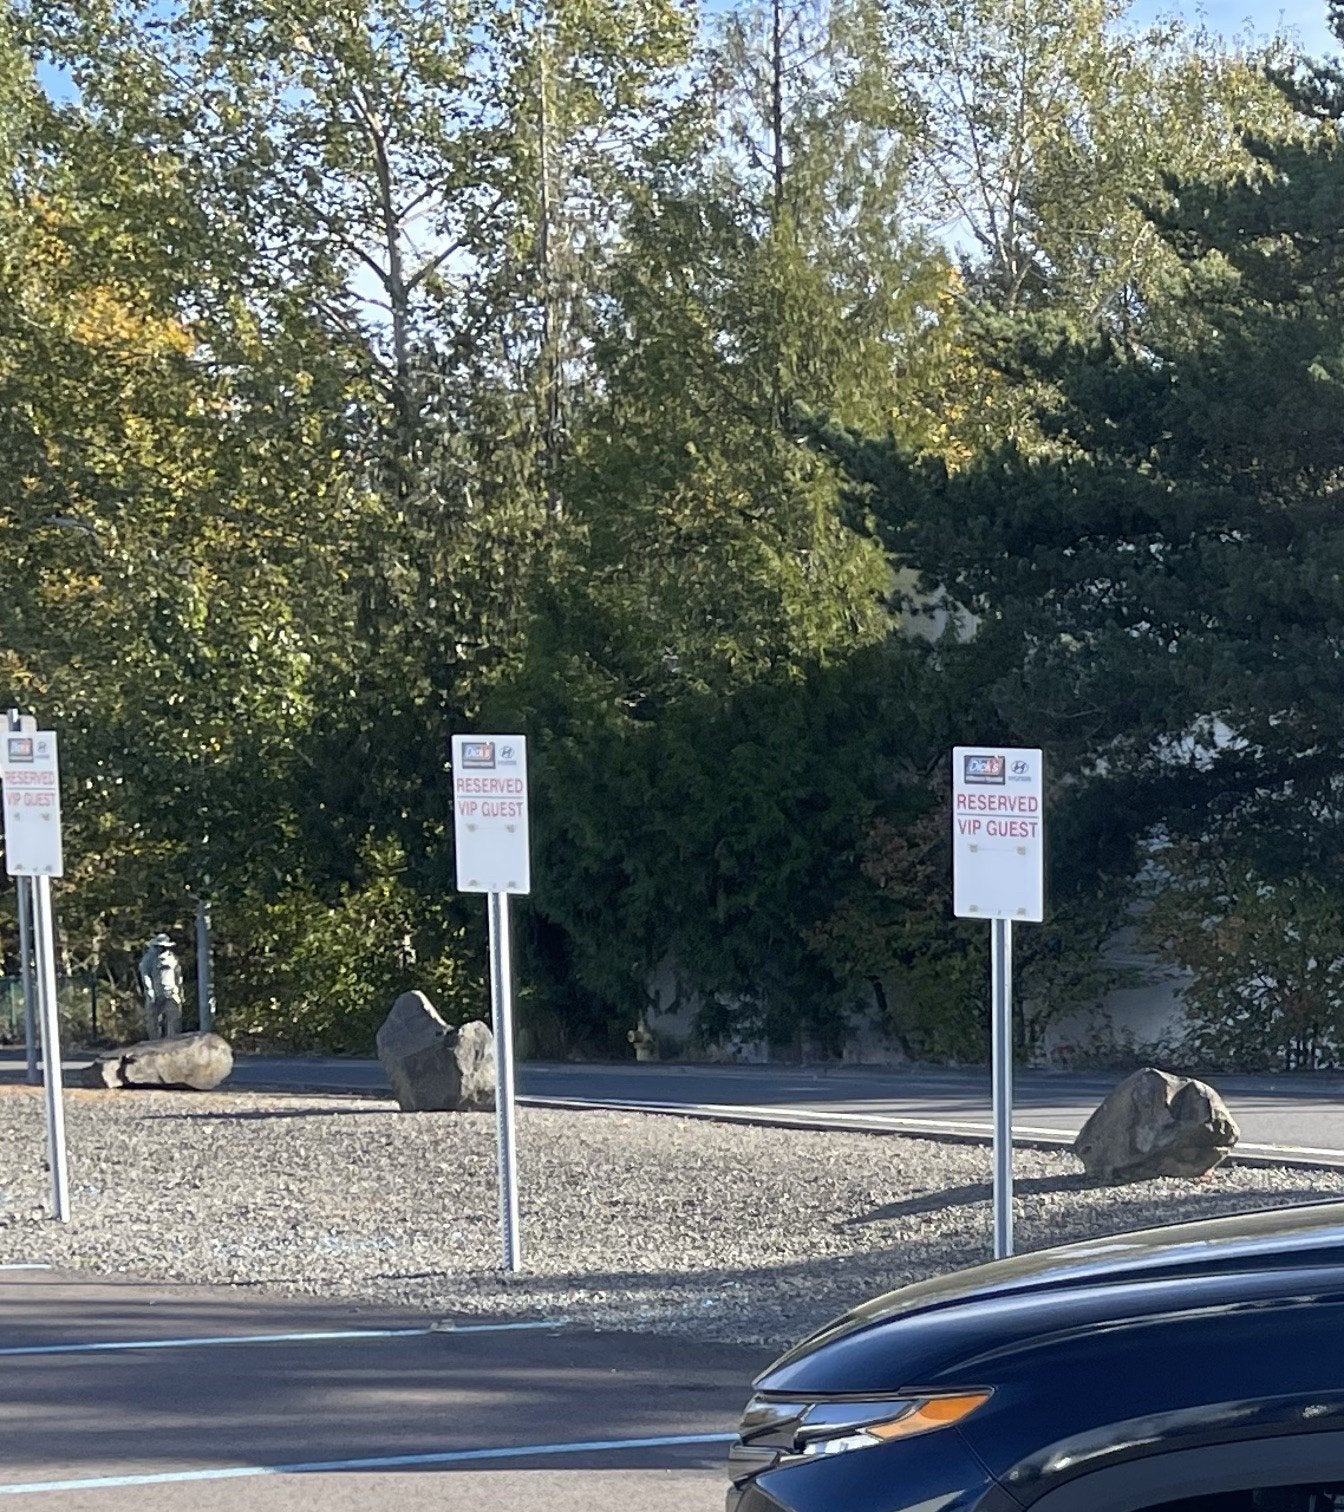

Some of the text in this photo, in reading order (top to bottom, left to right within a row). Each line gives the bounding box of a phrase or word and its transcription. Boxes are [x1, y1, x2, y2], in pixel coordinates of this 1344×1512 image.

[457, 778, 523, 793] RESERVED
[459, 800, 524, 817] VIP GUEST
[957, 794, 1038, 812] RESERVED
[957, 819, 1038, 837] VIP GUEST
